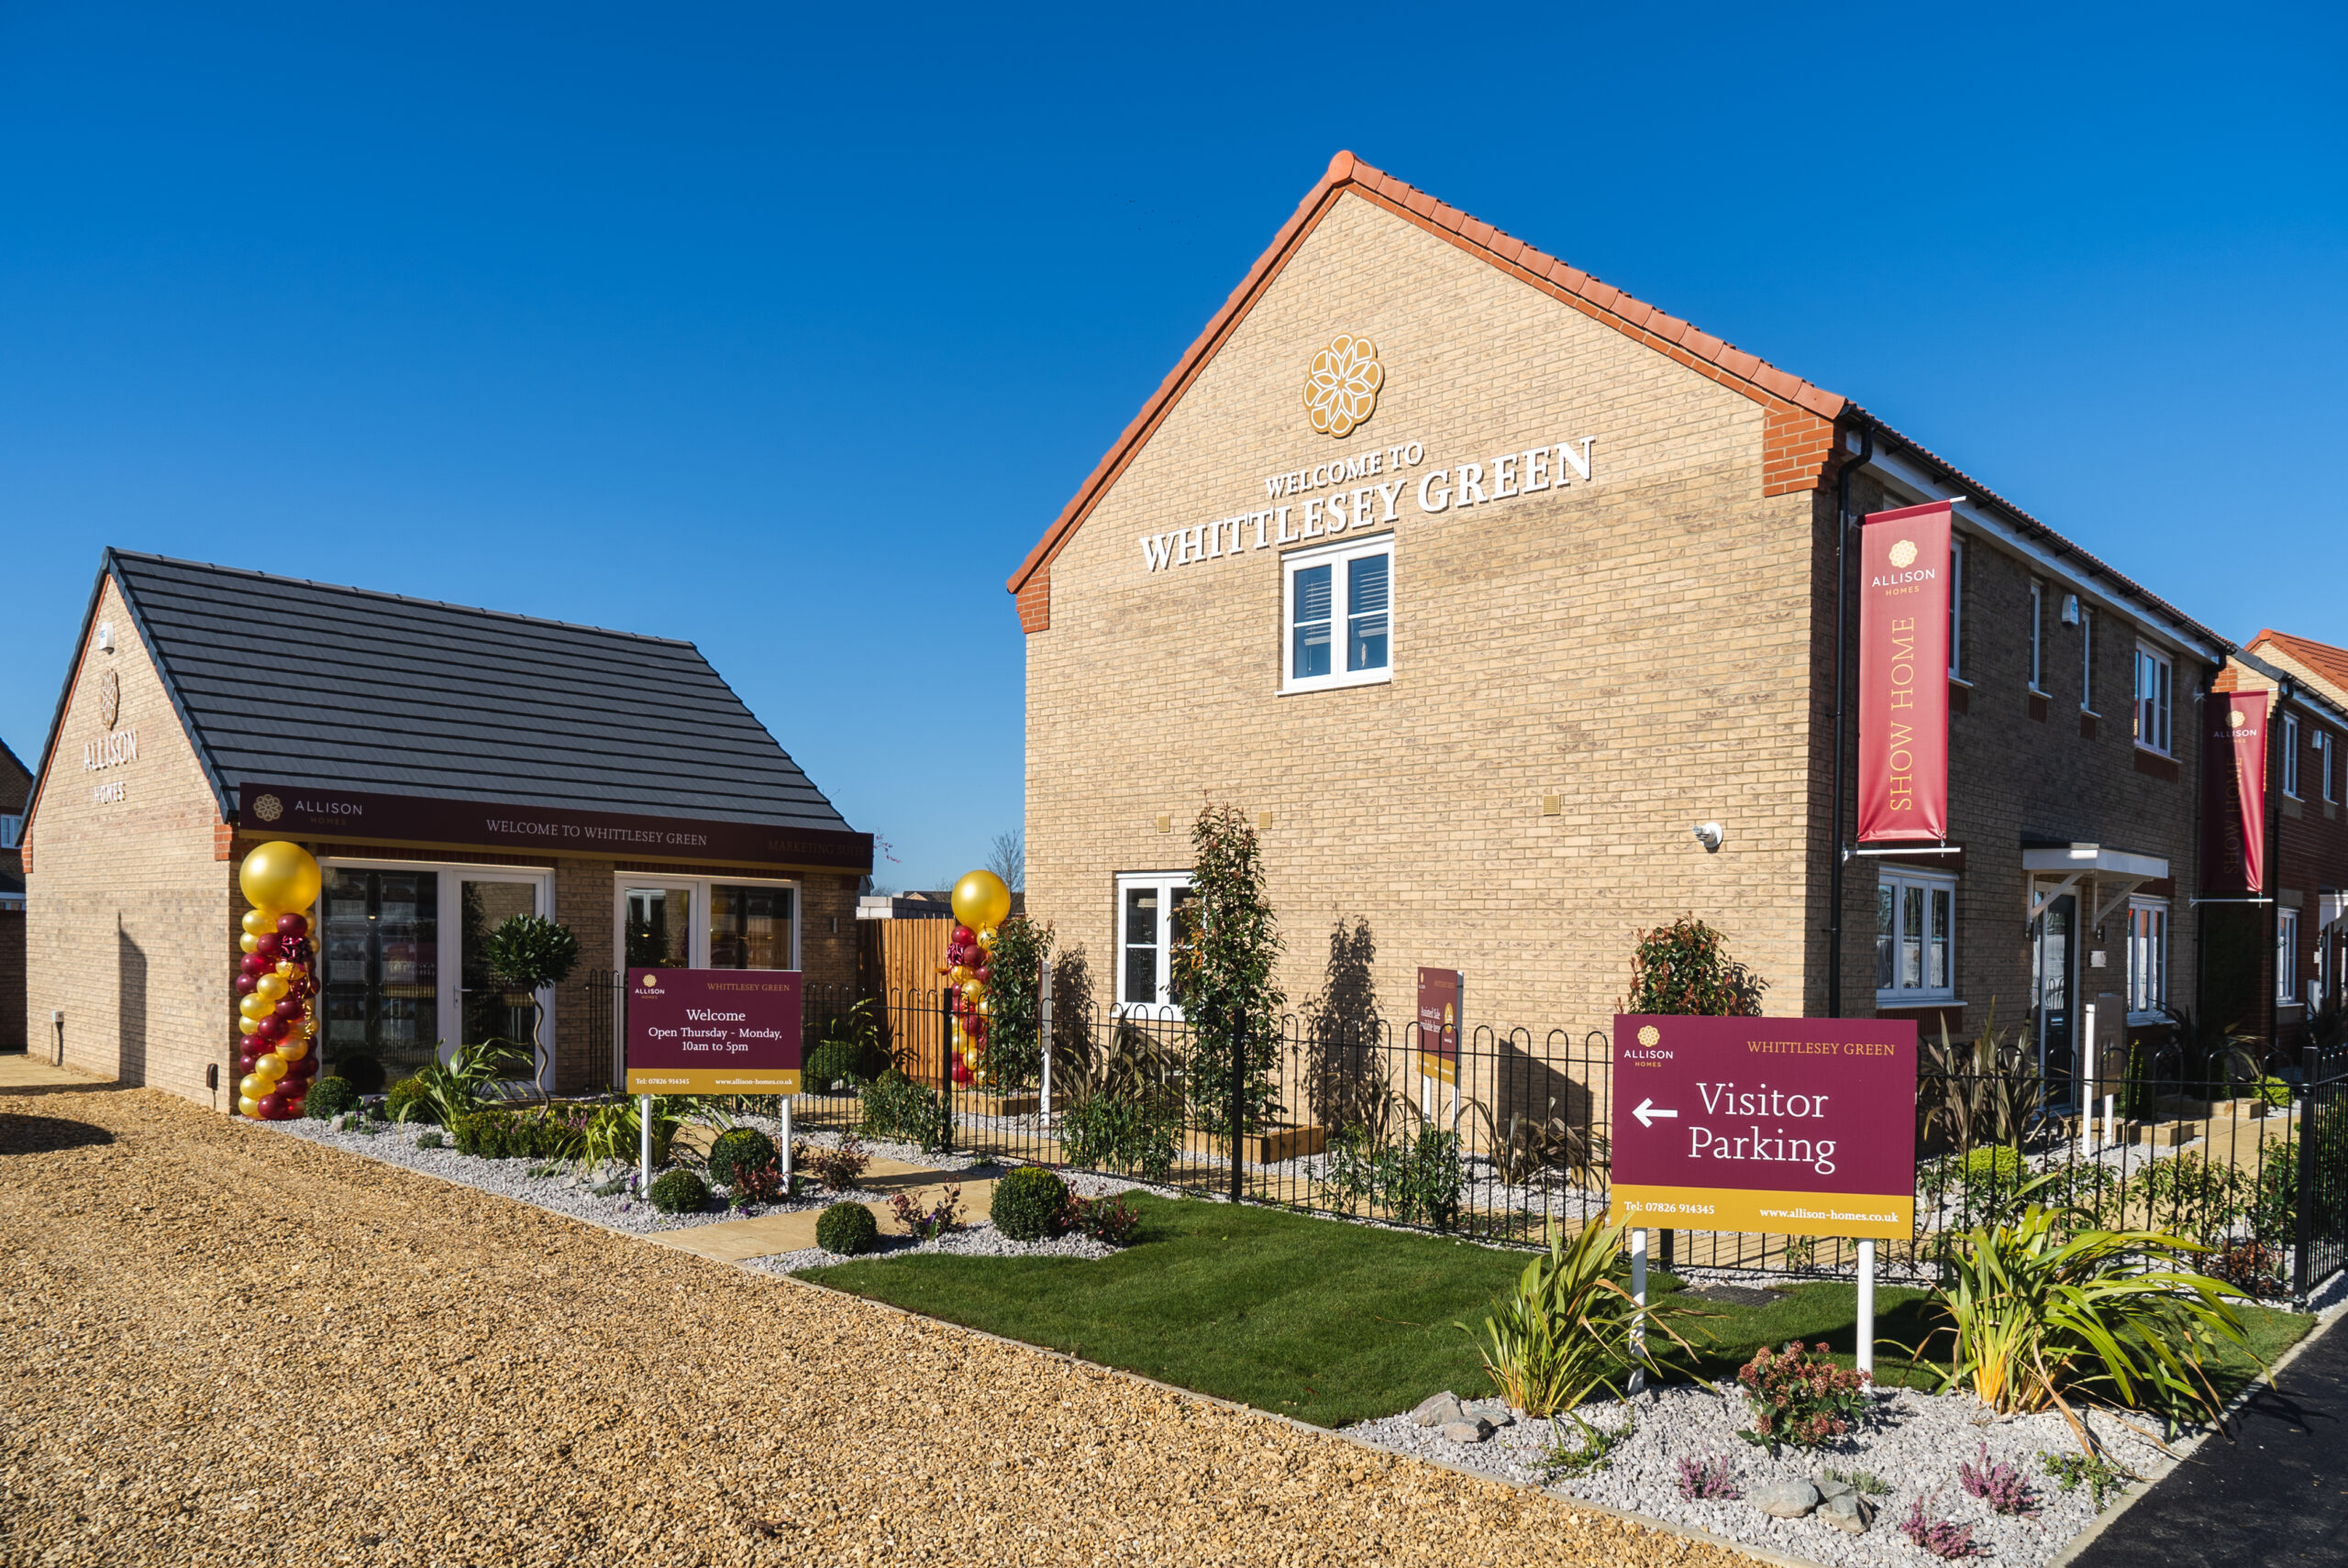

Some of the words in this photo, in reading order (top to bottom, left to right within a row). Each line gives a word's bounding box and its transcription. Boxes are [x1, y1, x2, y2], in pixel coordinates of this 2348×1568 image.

[1265, 451, 1383, 499] WELCOME
[1389, 441, 1425, 469] TO
[1139, 480, 1407, 572] WHITTLESEY
[1417, 436, 1597, 513] GREEN
[1871, 568, 1936, 588] ALLISON
[1886, 585, 1920, 596] HOMES
[1891, 617, 1915, 711] HOME
[2213, 729, 2257, 737] ALLISON
[83, 729, 138, 770] ALLISON
[1889, 721, 1913, 811] SHOW
[93, 781, 124, 803] HOMES
[2226, 757, 2243, 812] HOME
[294, 800, 363, 815] ALLISON
[310, 816, 347, 825] HOMES
[486, 819, 559, 836] WELCOME
[561, 824, 581, 837] TO
[584, 826, 664, 844] WHITTLESEY
[666, 833, 707, 846] GREEN
[768, 839, 834, 855] MARKETING
[2224, 820, 2241, 873] SHOW
[707, 982, 759, 991] WHITTLESEY
[761, 983, 791, 992] GREEN
[686, 1009, 747, 1021] Welcome
[648, 1026, 678, 1040] Open
[681, 1027, 728, 1041] Thursday
[739, 1028, 782, 1041] Monday,
[682, 1041, 709, 1051] 10am
[712, 1042, 724, 1051] to
[725, 1042, 749, 1055] 5pm
[1623, 1049, 1674, 1060] ALLISON
[1747, 1041, 1840, 1055] WHITTLESEY
[1844, 1043, 1896, 1055] GREEN
[714, 1077, 793, 1086] www.allison-homes.co.uk
[1696, 1082, 1830, 1118] Visitor
[1688, 1126, 1837, 1175] Parking
[1623, 1200, 1643, 1211] Tel:
[1645, 1202, 1677, 1213] 07826
[1678, 1203, 1715, 1215] 914345
[1759, 1207, 1899, 1222] www.allison-homes.co.uk
